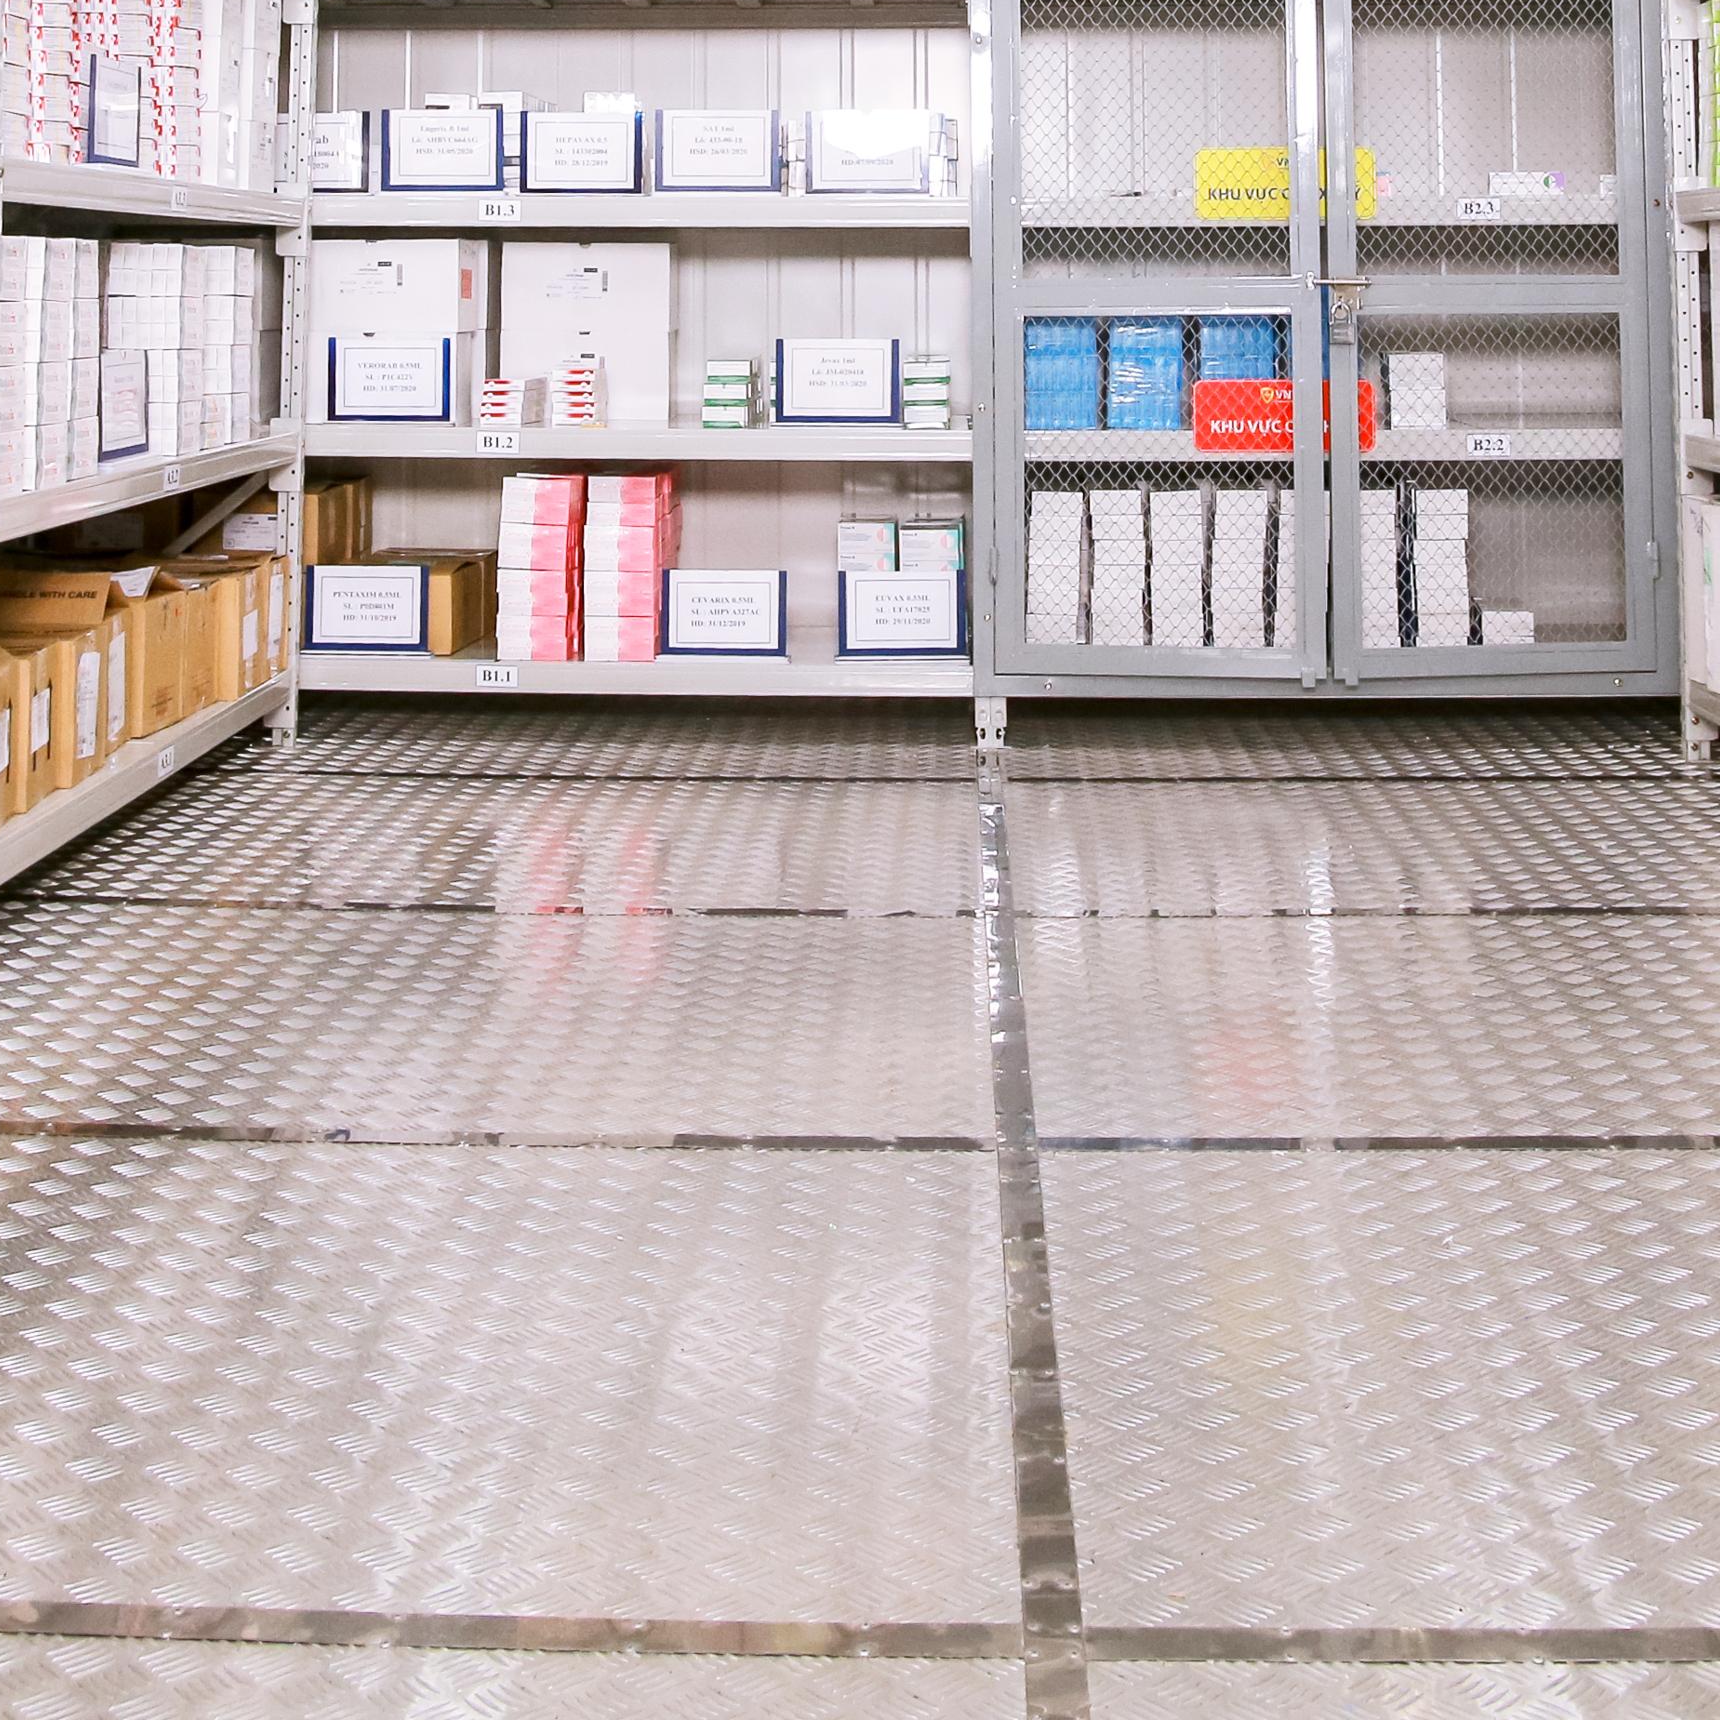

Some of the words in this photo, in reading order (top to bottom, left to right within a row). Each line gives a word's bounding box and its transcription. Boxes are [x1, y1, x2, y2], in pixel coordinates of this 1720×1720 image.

[1208, 187, 1241, 202] KHU
[1245, 186, 1279, 206] VỰC
[485, 203, 515, 216] B1.3
[1464, 201, 1494, 215] B2.3
[357, 362, 397, 370] VERORAB
[1210, 420, 1246, 434] KHU
[1248, 418, 1282, 437] VỰC
[483, 436, 513, 449] B1.2
[1473, 438, 1504, 452] B2.2
[38, 590, 66, 599] WITH
[67, 590, 99, 600] CARE
[482, 669, 511, 682] B1.1
